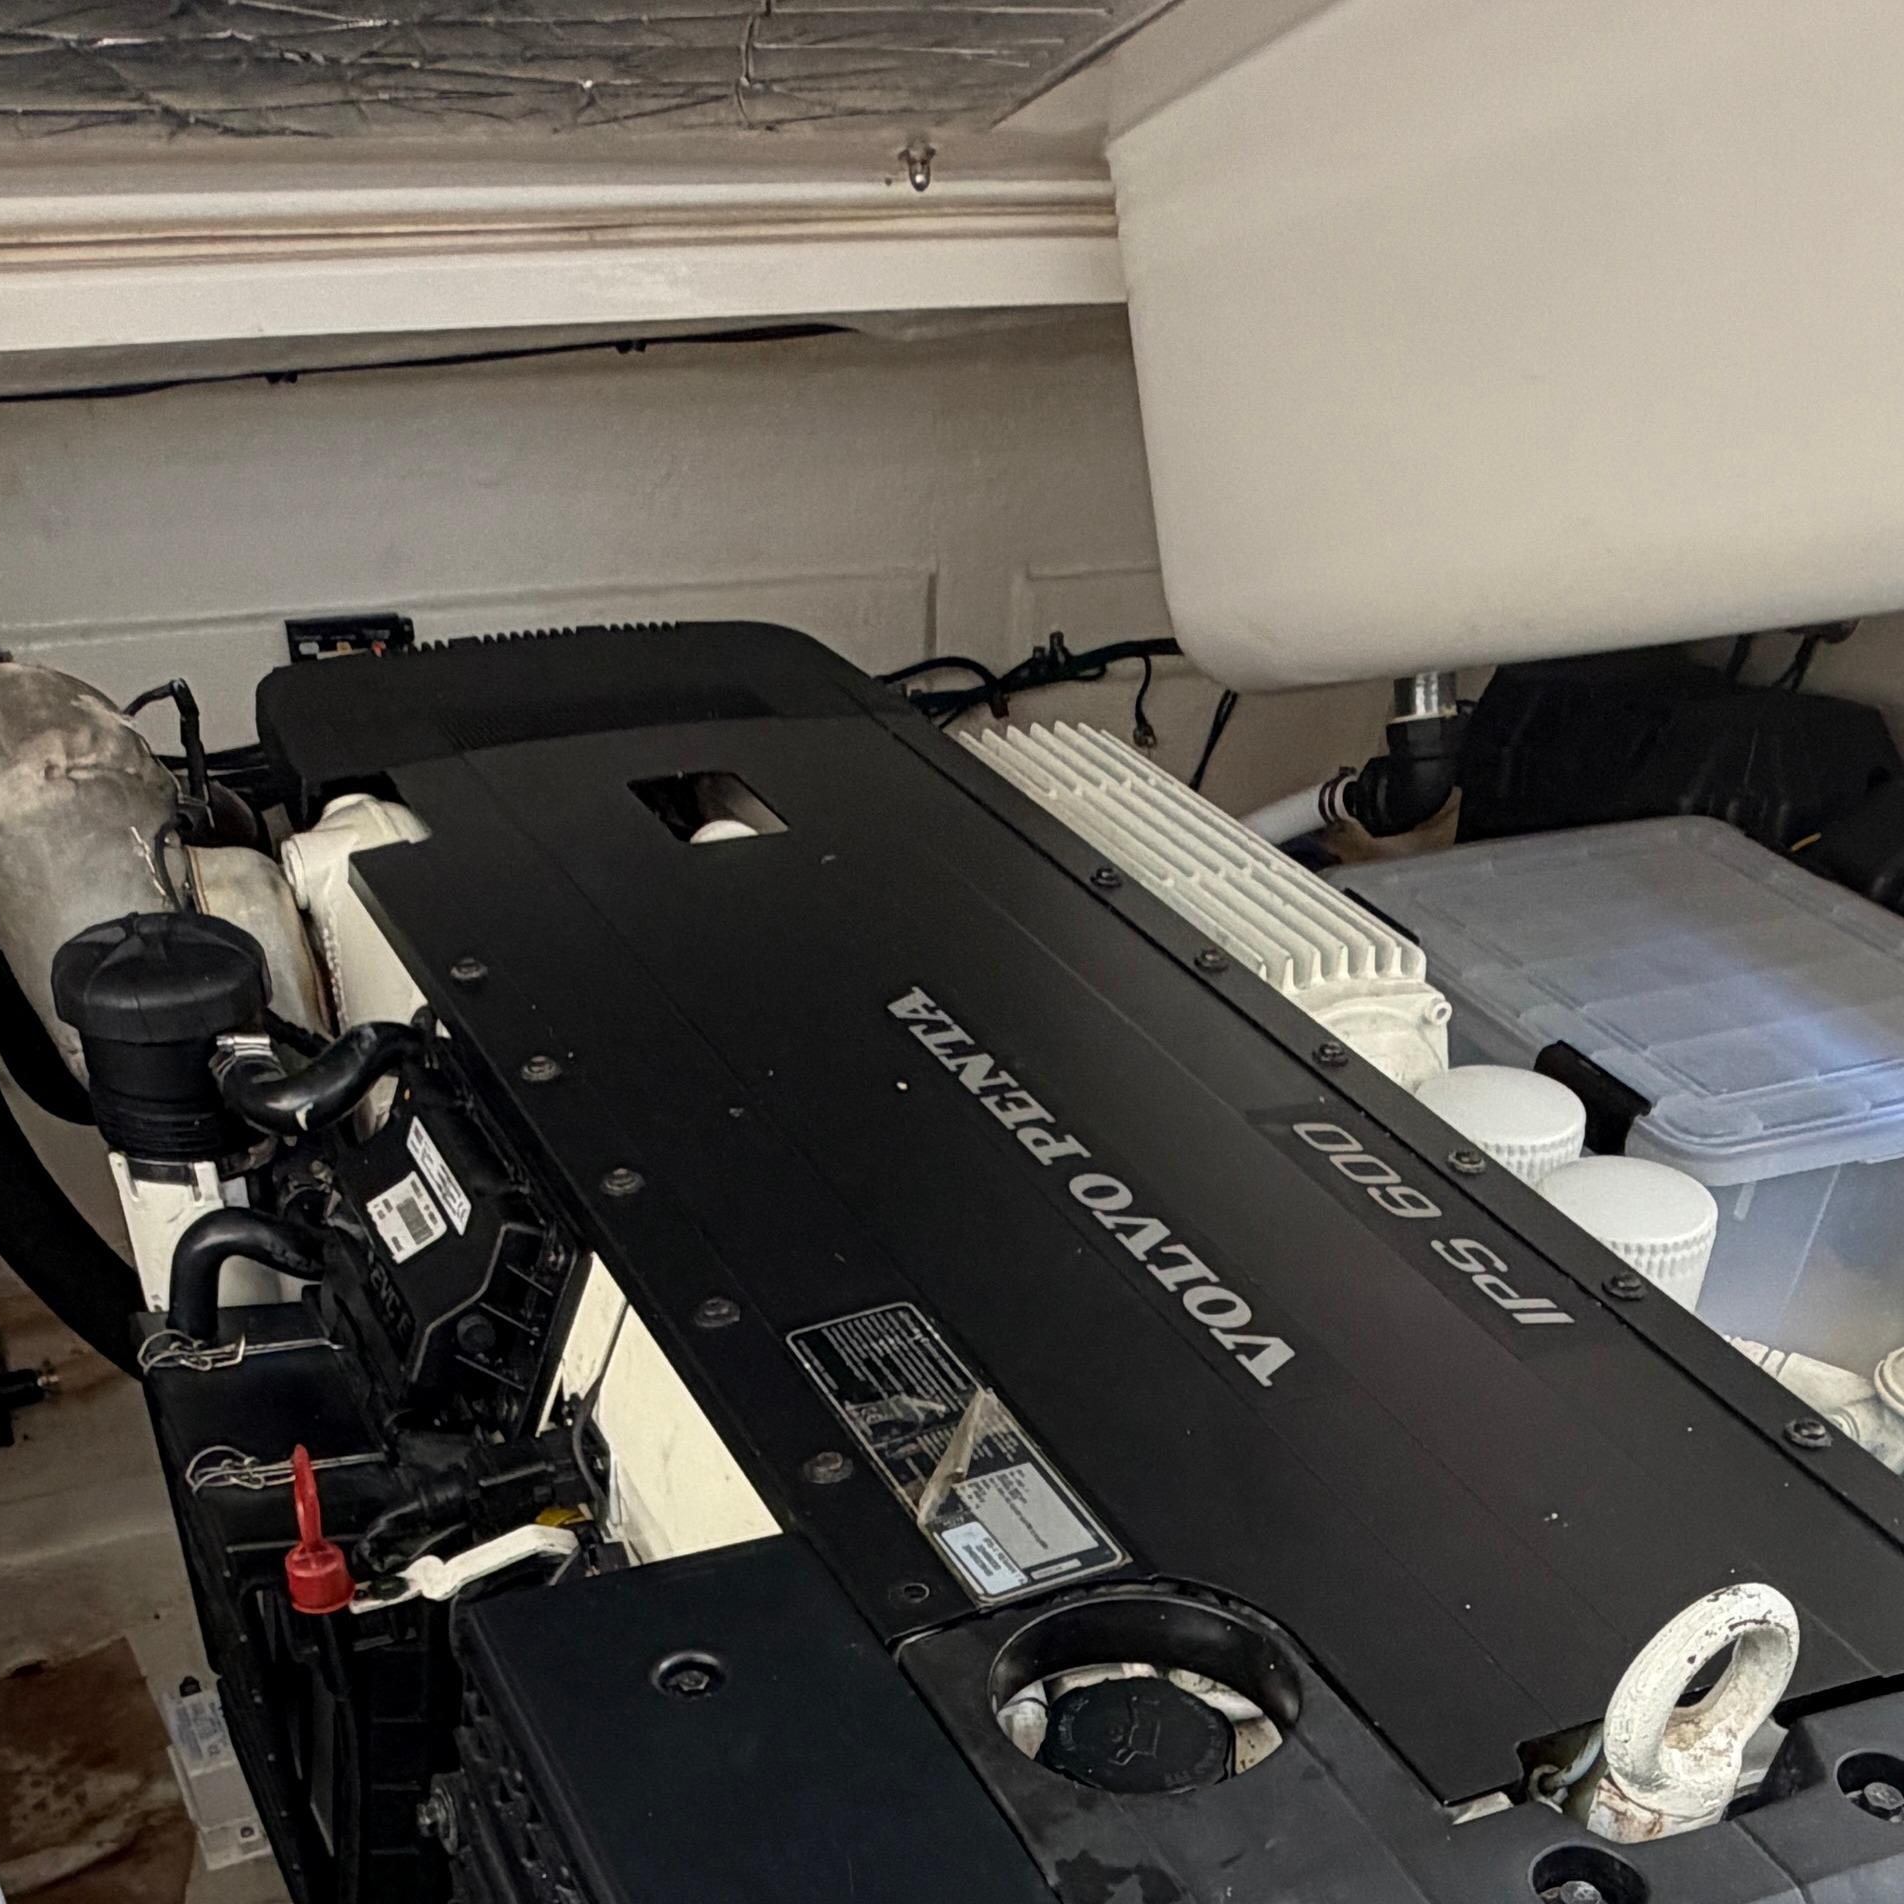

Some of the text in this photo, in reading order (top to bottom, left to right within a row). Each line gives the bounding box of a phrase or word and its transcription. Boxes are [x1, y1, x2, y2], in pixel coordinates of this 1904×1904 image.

[887, 986, 1092, 1166] PENTA
[1069, 1173, 1296, 1387] VOLVO
[1293, 1123, 1575, 1324] IPS 600
